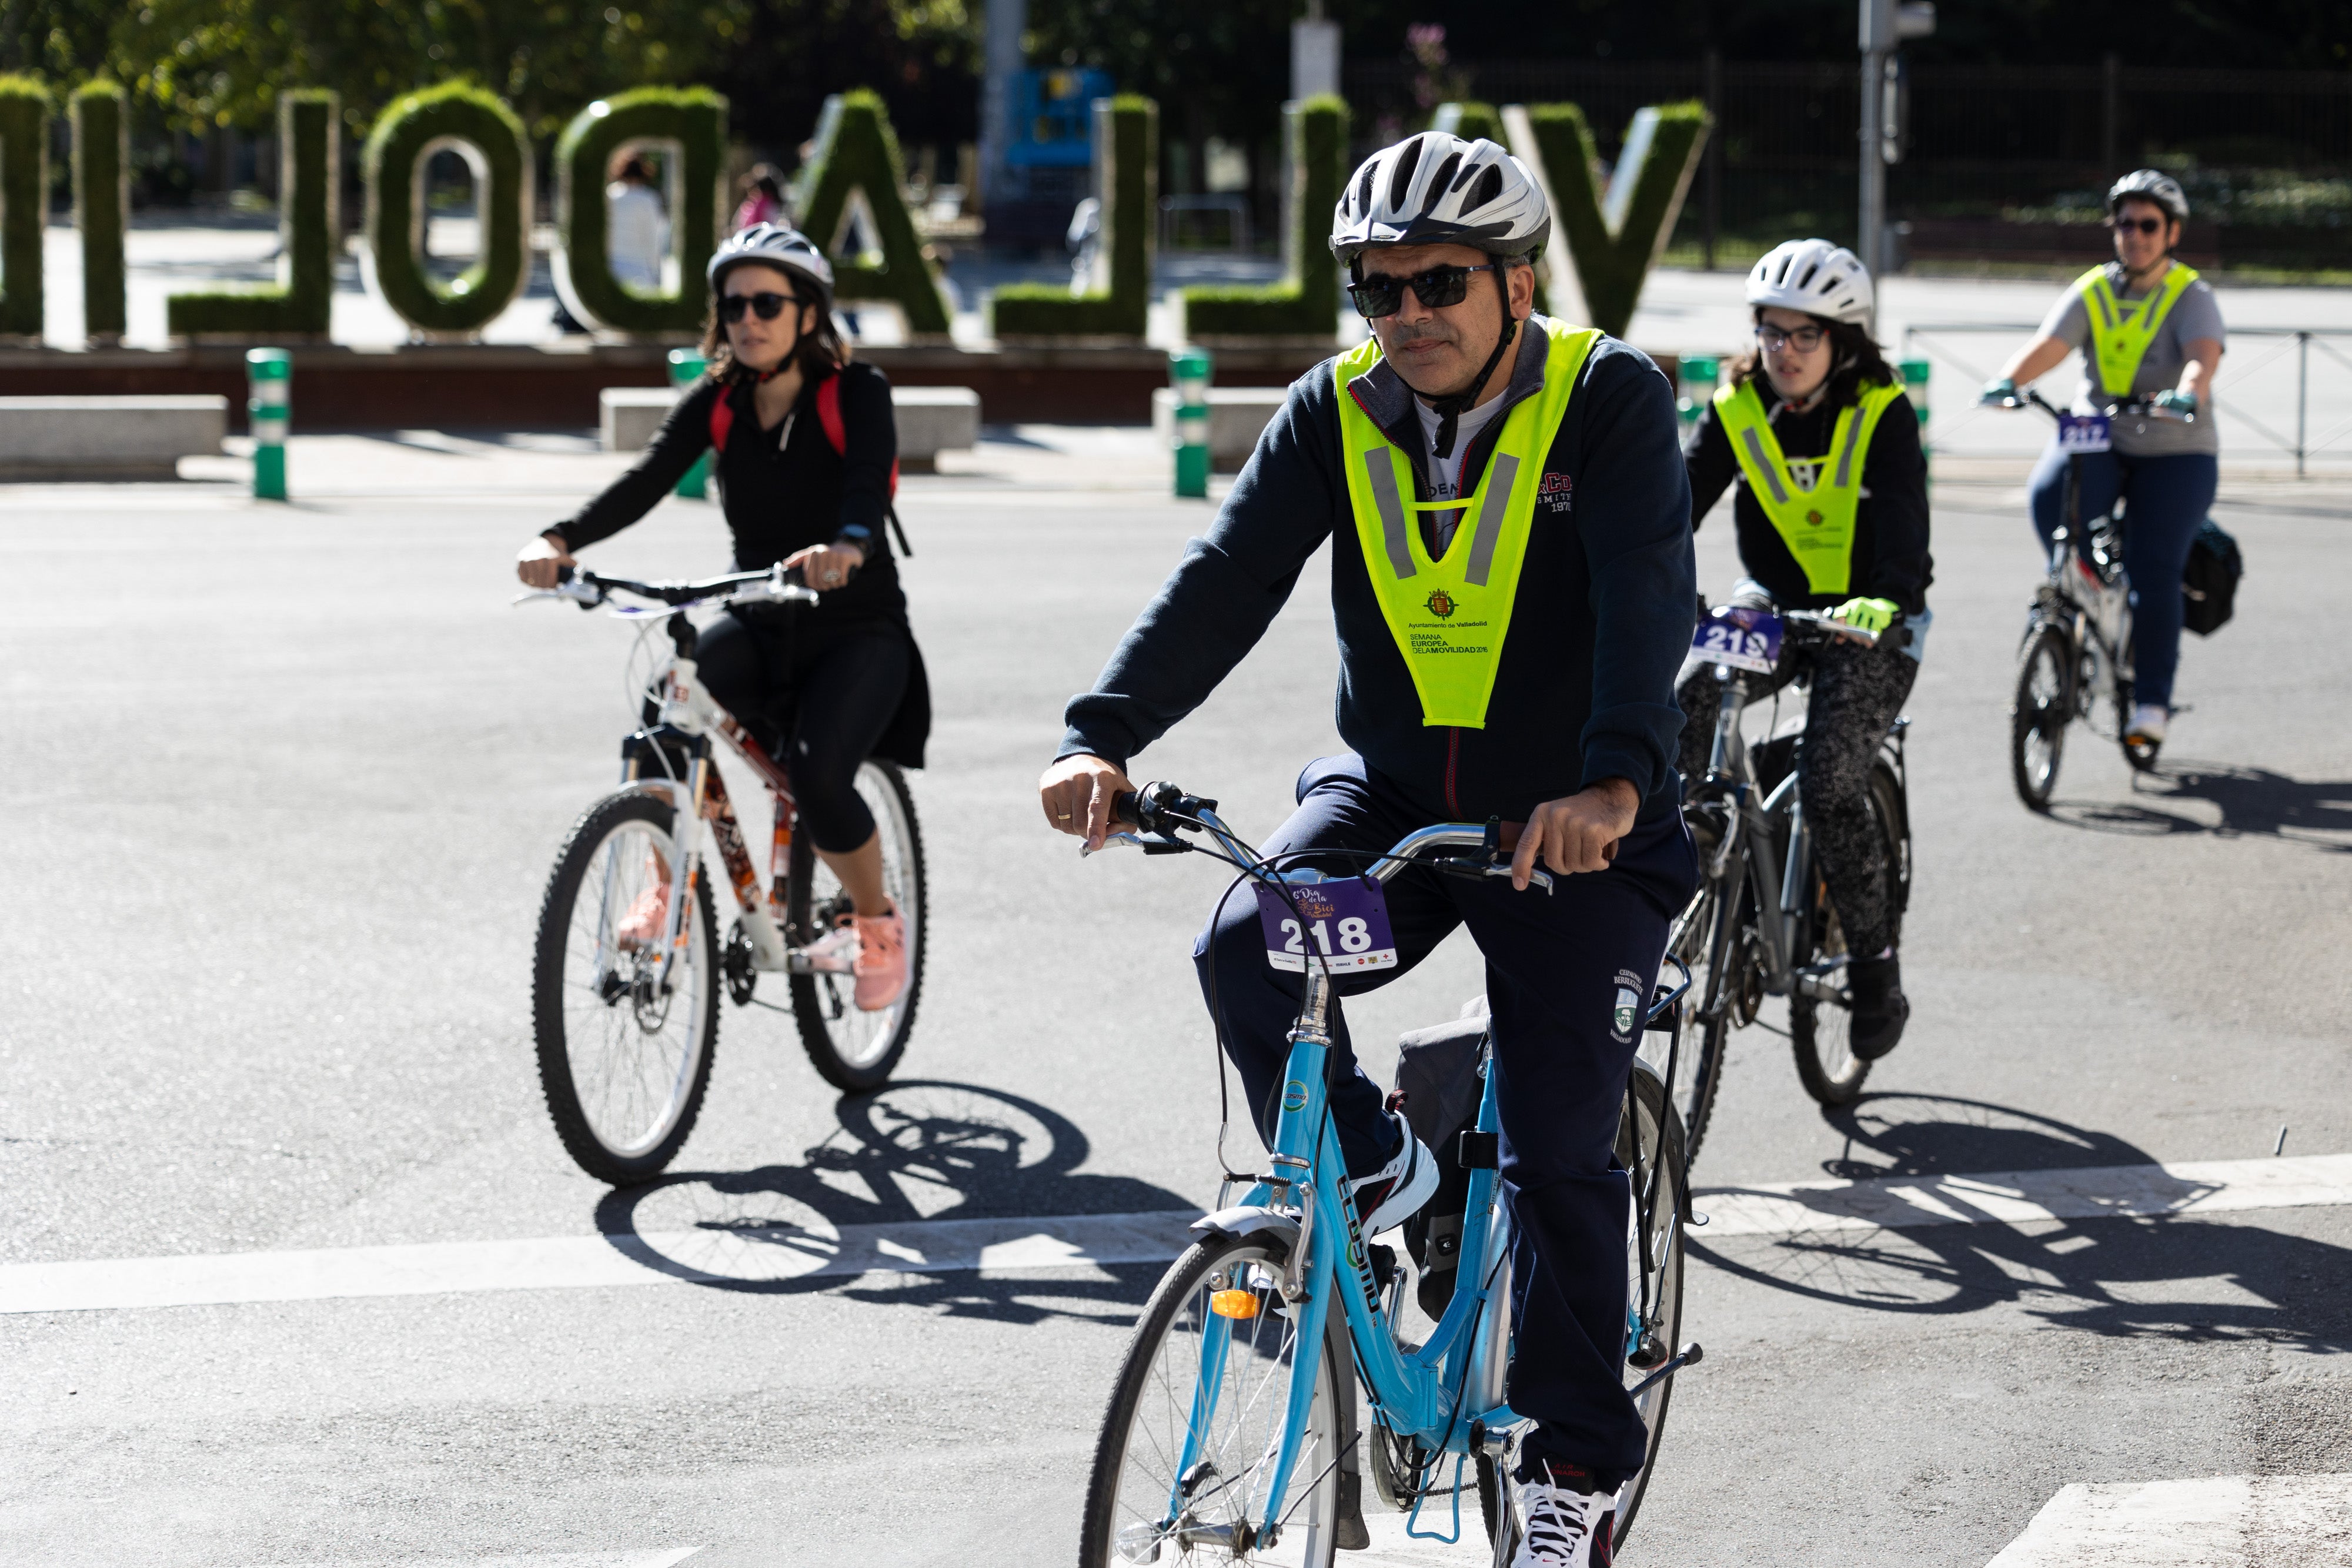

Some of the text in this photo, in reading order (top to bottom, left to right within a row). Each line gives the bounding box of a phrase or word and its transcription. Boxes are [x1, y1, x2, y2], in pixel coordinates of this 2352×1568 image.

[1703, 624, 1769, 658] 219
[1314, 902, 1334, 914] Bici
[1281, 917, 1372, 955] 218
[1614, 976, 1643, 995] BERRUGUETE
[1610, 1028, 1632, 1044] VALLADOLID
